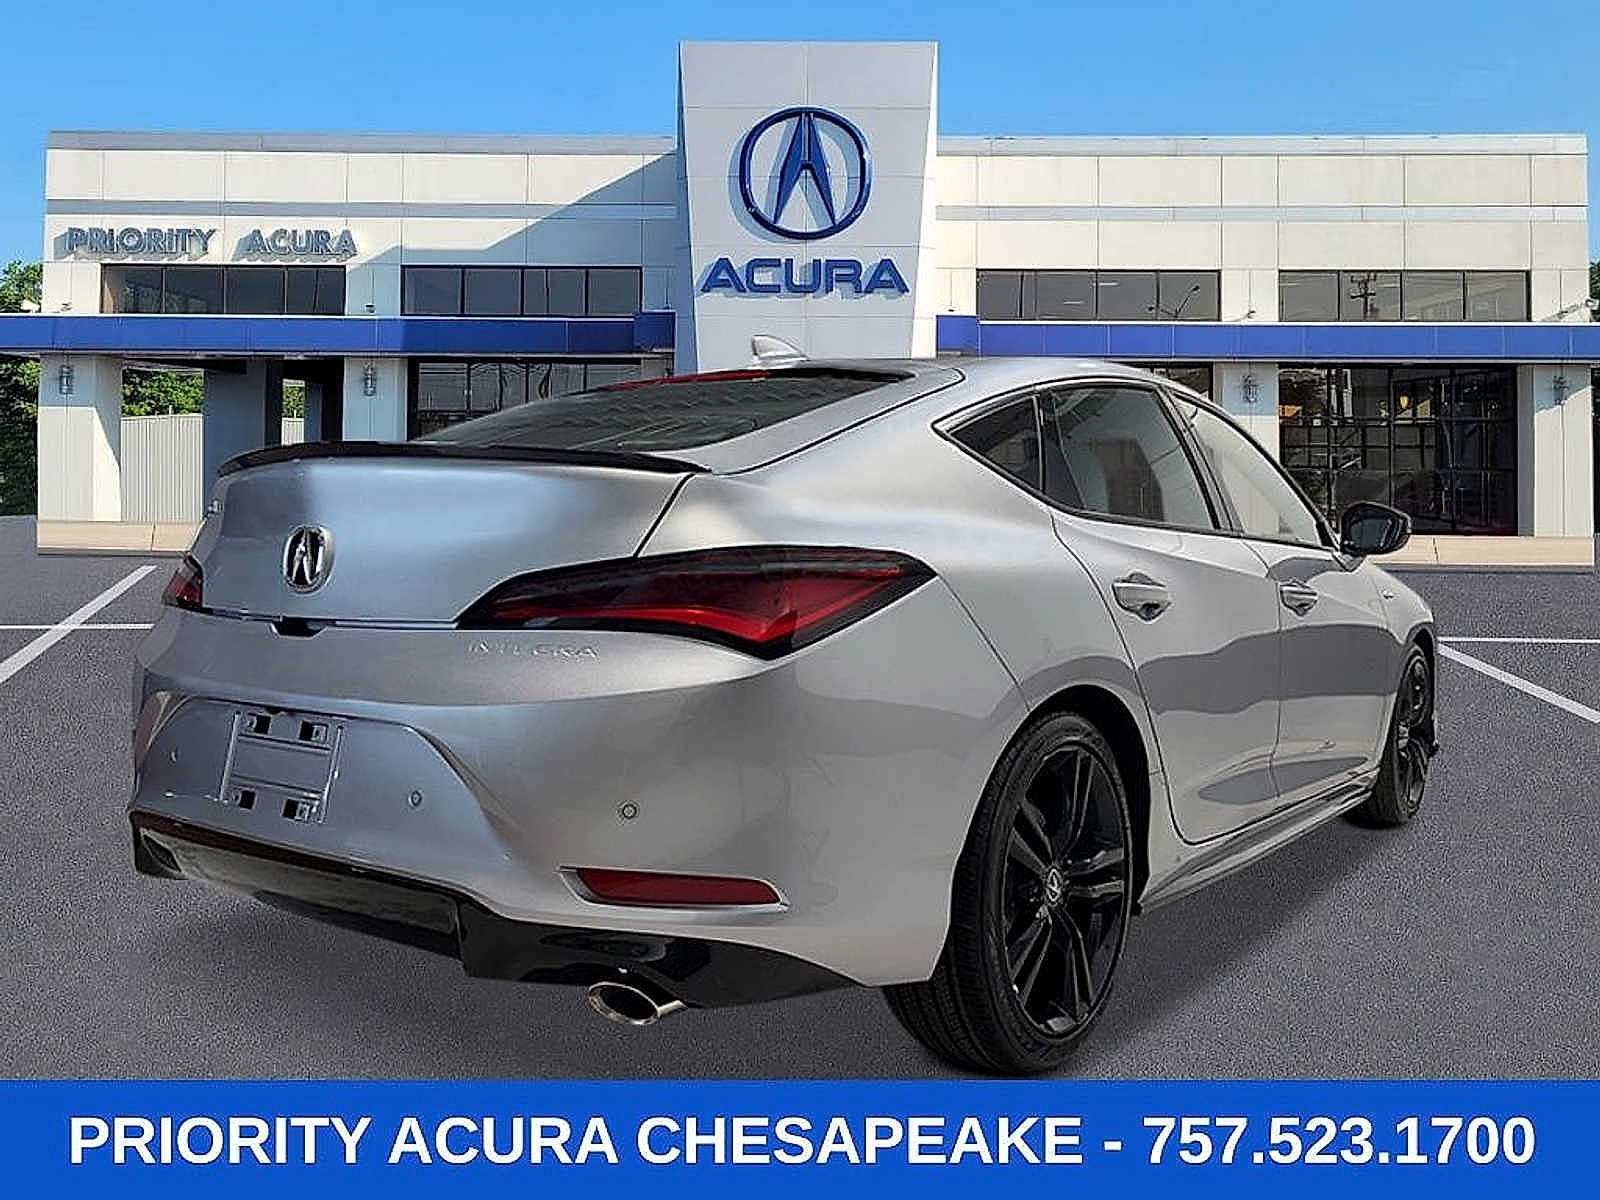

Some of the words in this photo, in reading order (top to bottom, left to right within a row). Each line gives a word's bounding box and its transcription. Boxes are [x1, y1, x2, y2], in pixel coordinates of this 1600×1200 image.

[66, 227, 216, 253] PRIORITY
[247, 229, 357, 255] ACURA
[701, 257, 909, 293] ACURA
